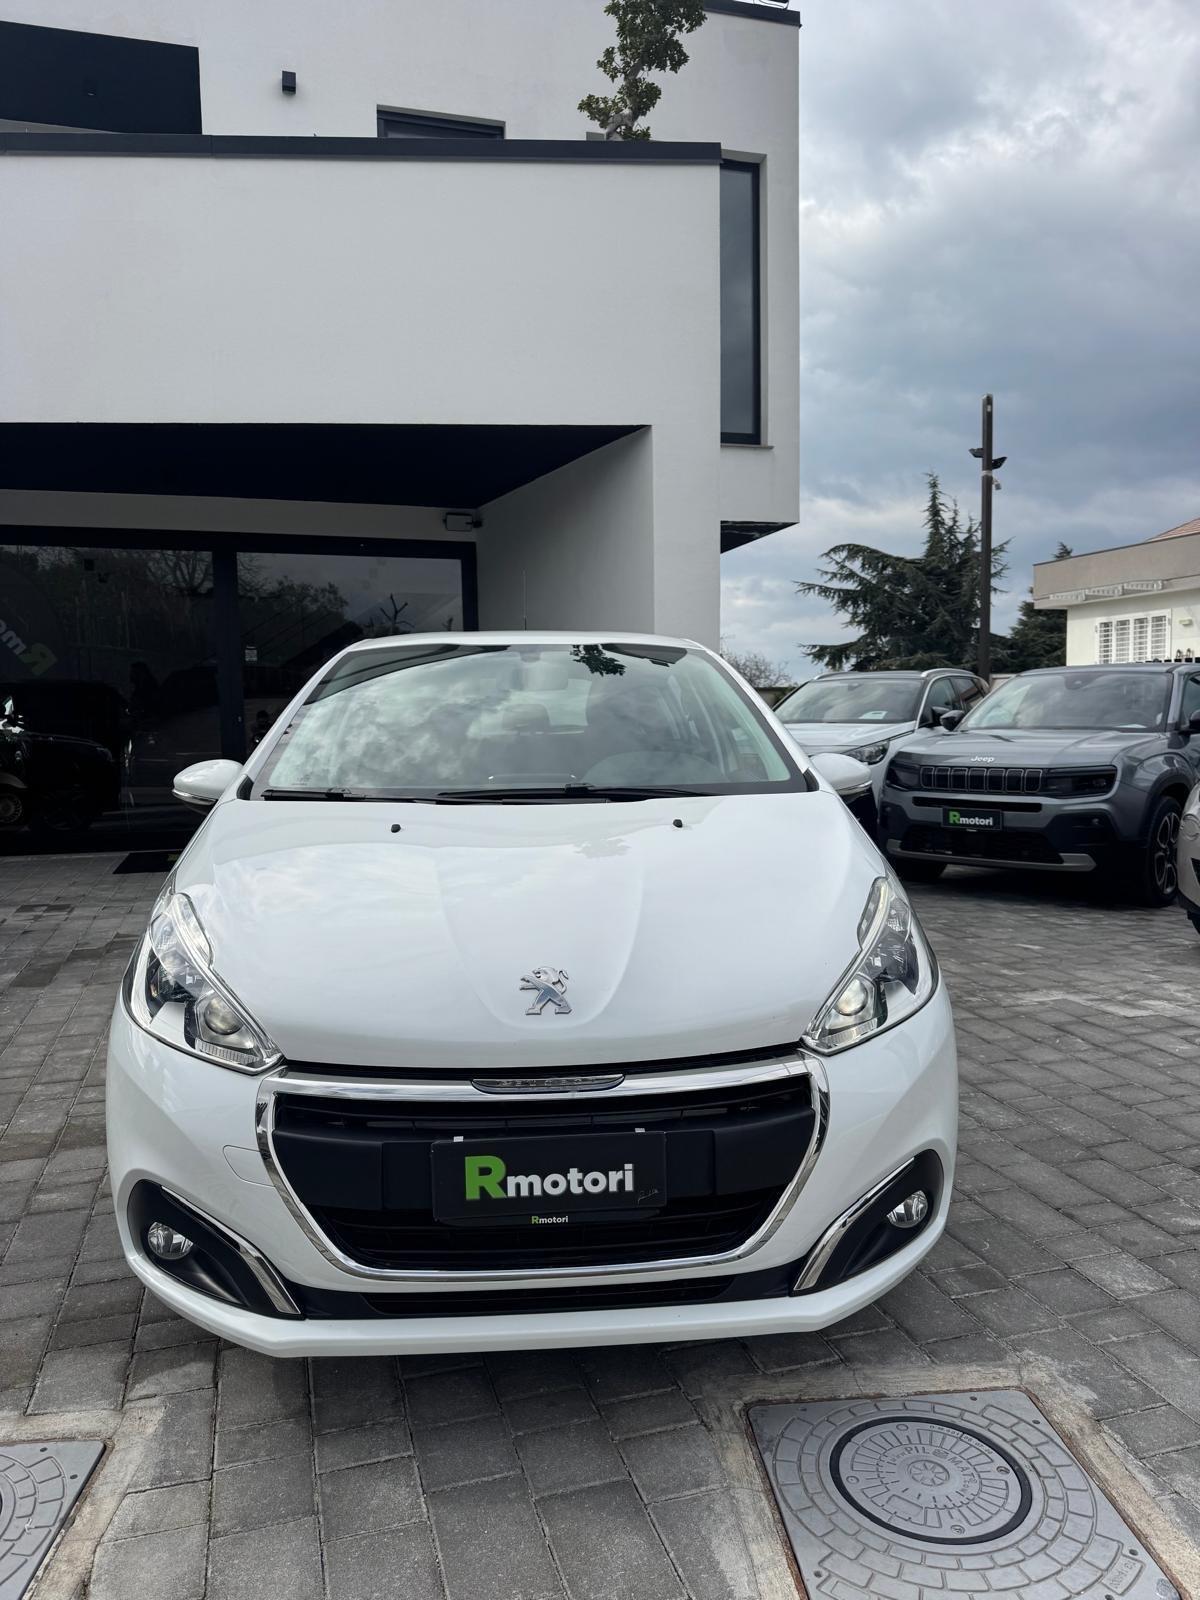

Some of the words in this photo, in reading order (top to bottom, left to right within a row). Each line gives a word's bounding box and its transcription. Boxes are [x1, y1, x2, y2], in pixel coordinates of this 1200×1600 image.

[970, 755, 995, 763] Jeep
[948, 811, 993, 826] Rmotori
[464, 1155, 634, 1200] Rmotori
[531, 1215, 569, 1225] Rmotori
